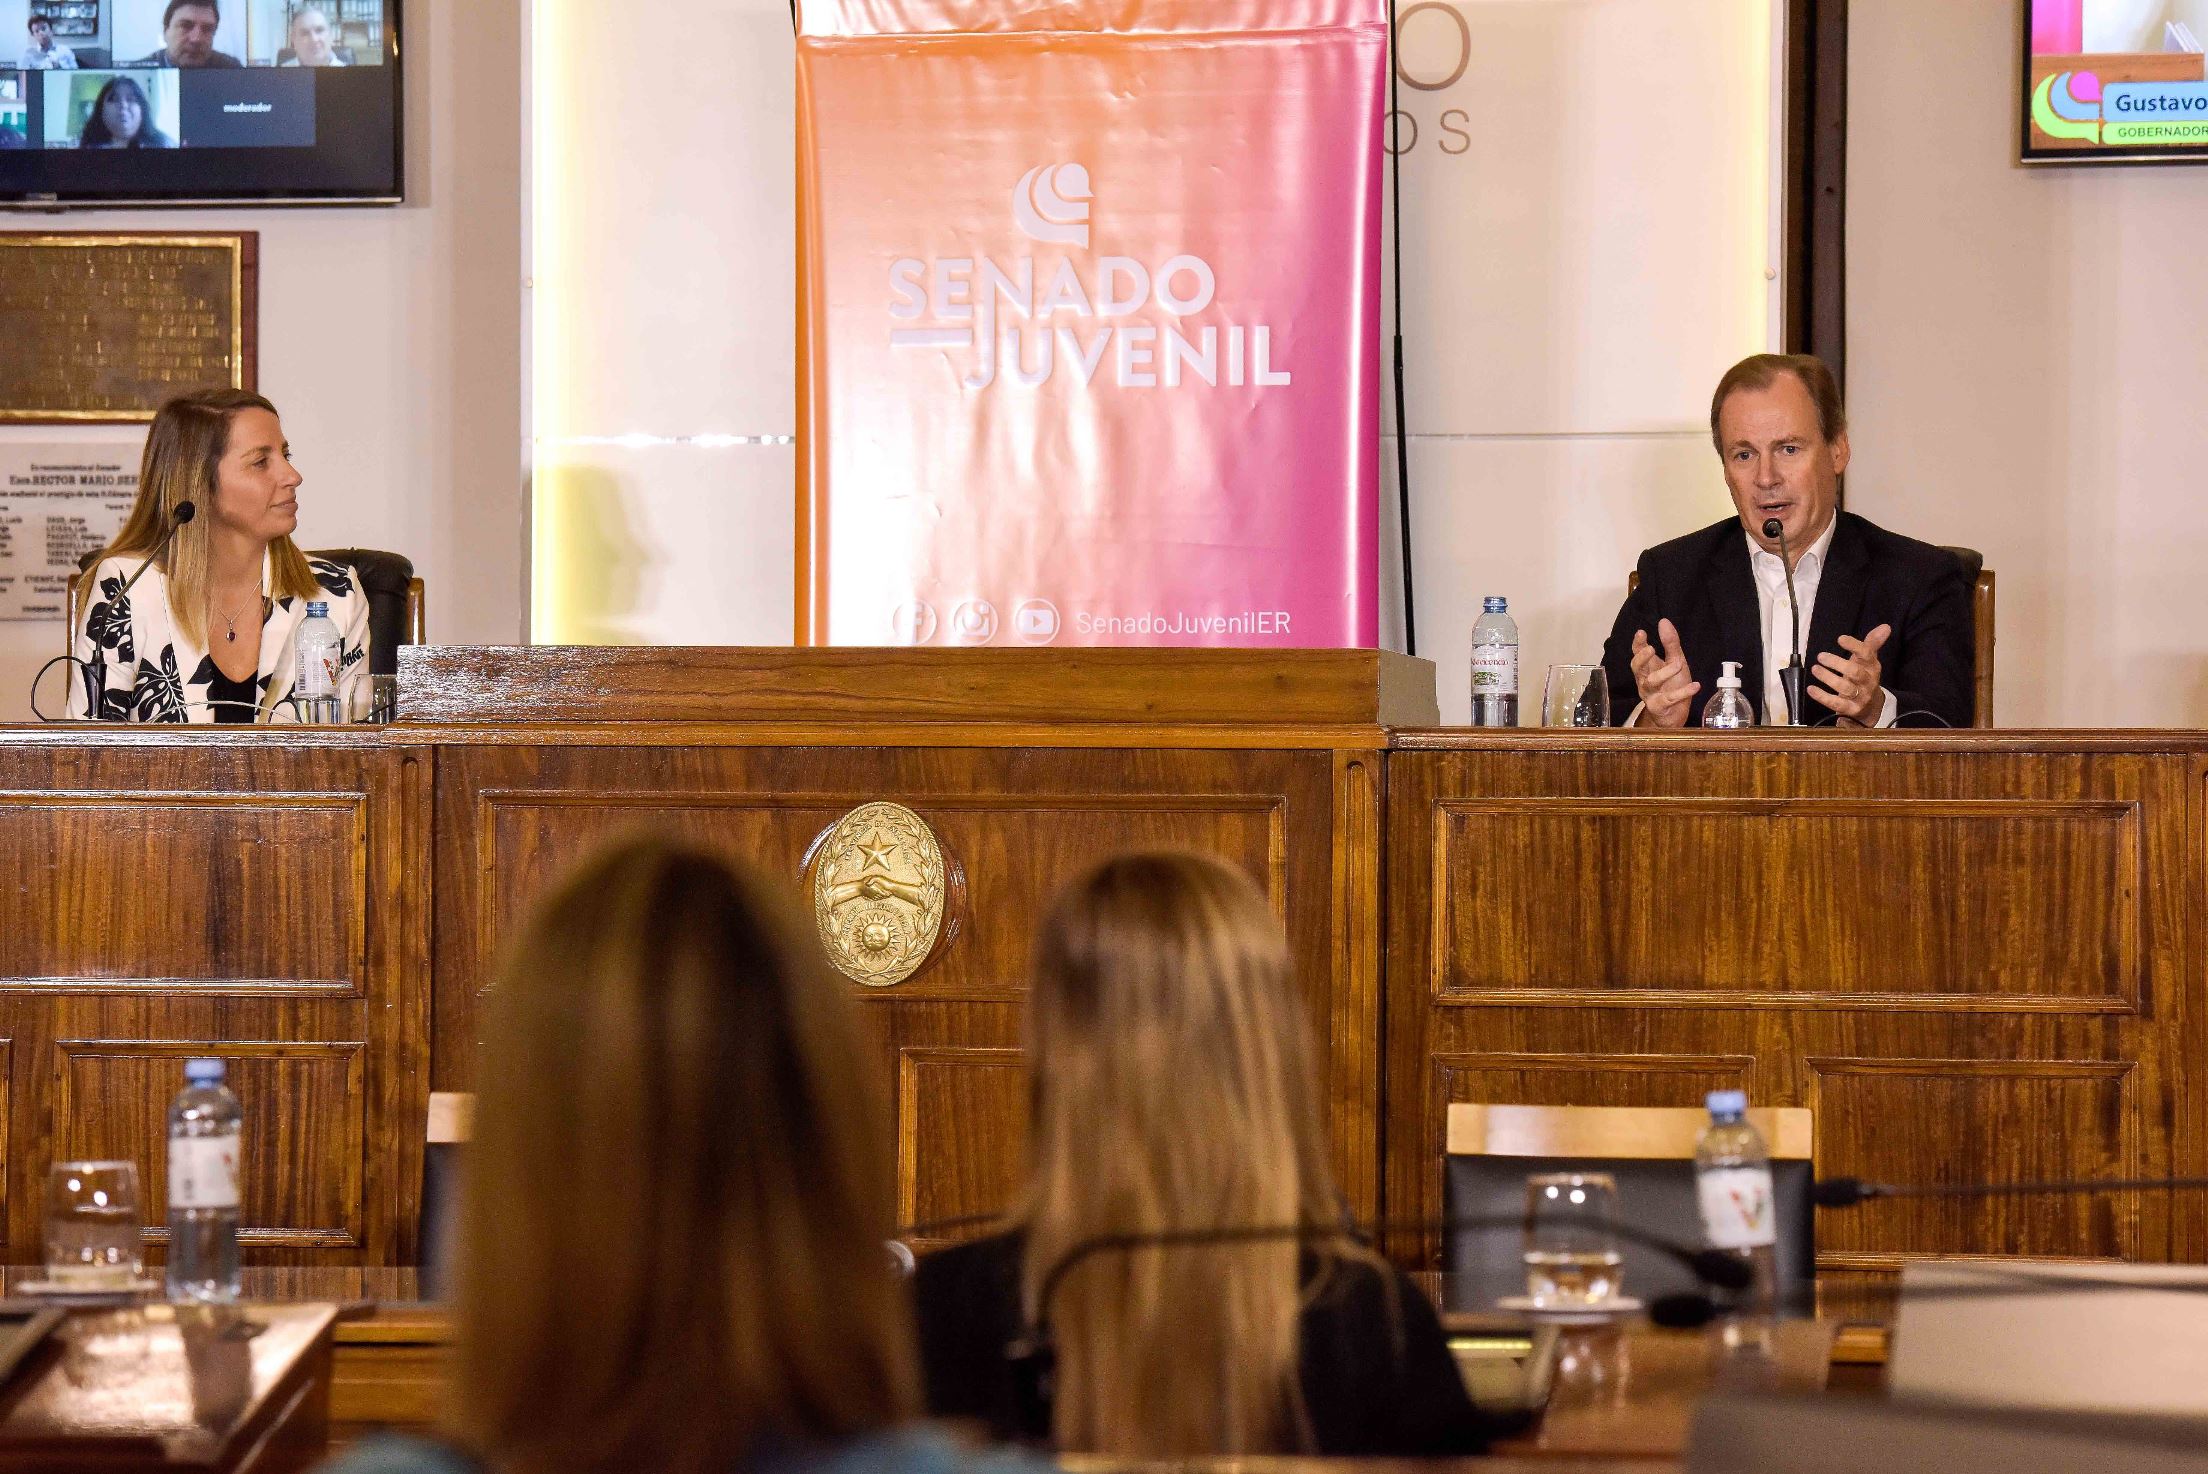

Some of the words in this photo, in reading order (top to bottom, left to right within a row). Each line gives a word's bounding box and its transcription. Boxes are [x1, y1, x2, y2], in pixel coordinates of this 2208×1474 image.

[223, 102, 272, 113] moderador
[2115, 94, 2208, 113] Gustavo
[2118, 126, 2208, 138] GOBERNADOR
[888, 254, 1215, 319] SENADO
[963, 325, 1291, 388] JUVENIL
[1076, 611, 1291, 635] SenadoJuvenilER
